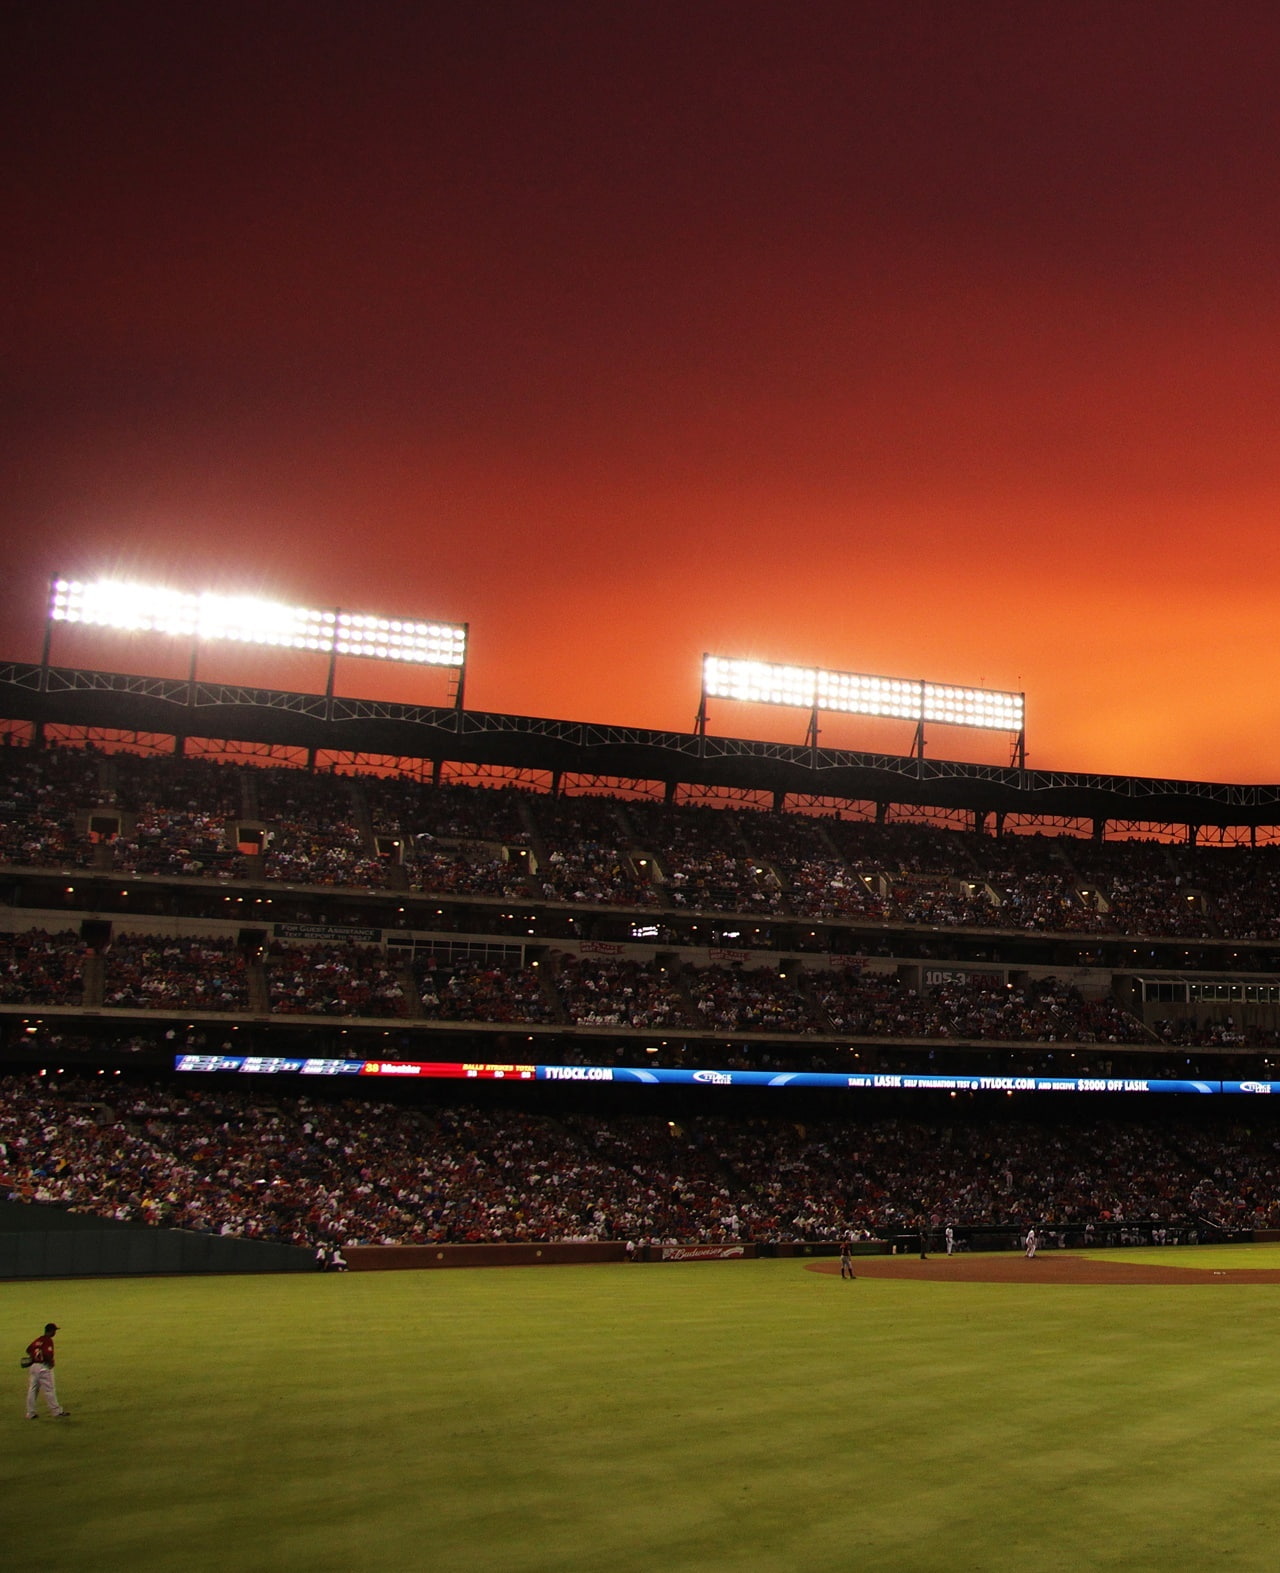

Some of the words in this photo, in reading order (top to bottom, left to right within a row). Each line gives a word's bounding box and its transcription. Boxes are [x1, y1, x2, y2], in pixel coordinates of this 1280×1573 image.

[365, 1063, 379, 1072] 38
[545, 1067, 613, 1080] TYLOCK.COM
[866, 1078, 872, 1086] A
[874, 1076, 902, 1087] LASIK
[957, 1080, 970, 1088] TEST
[971, 1080, 979, 1090] @
[980, 1078, 1036, 1090] TYLOCK.COM
[1078, 1079, 1105, 1091] $2000
[1107, 1080, 1123, 1091] OFF
[674, 1247, 723, 1260] Budweiser
